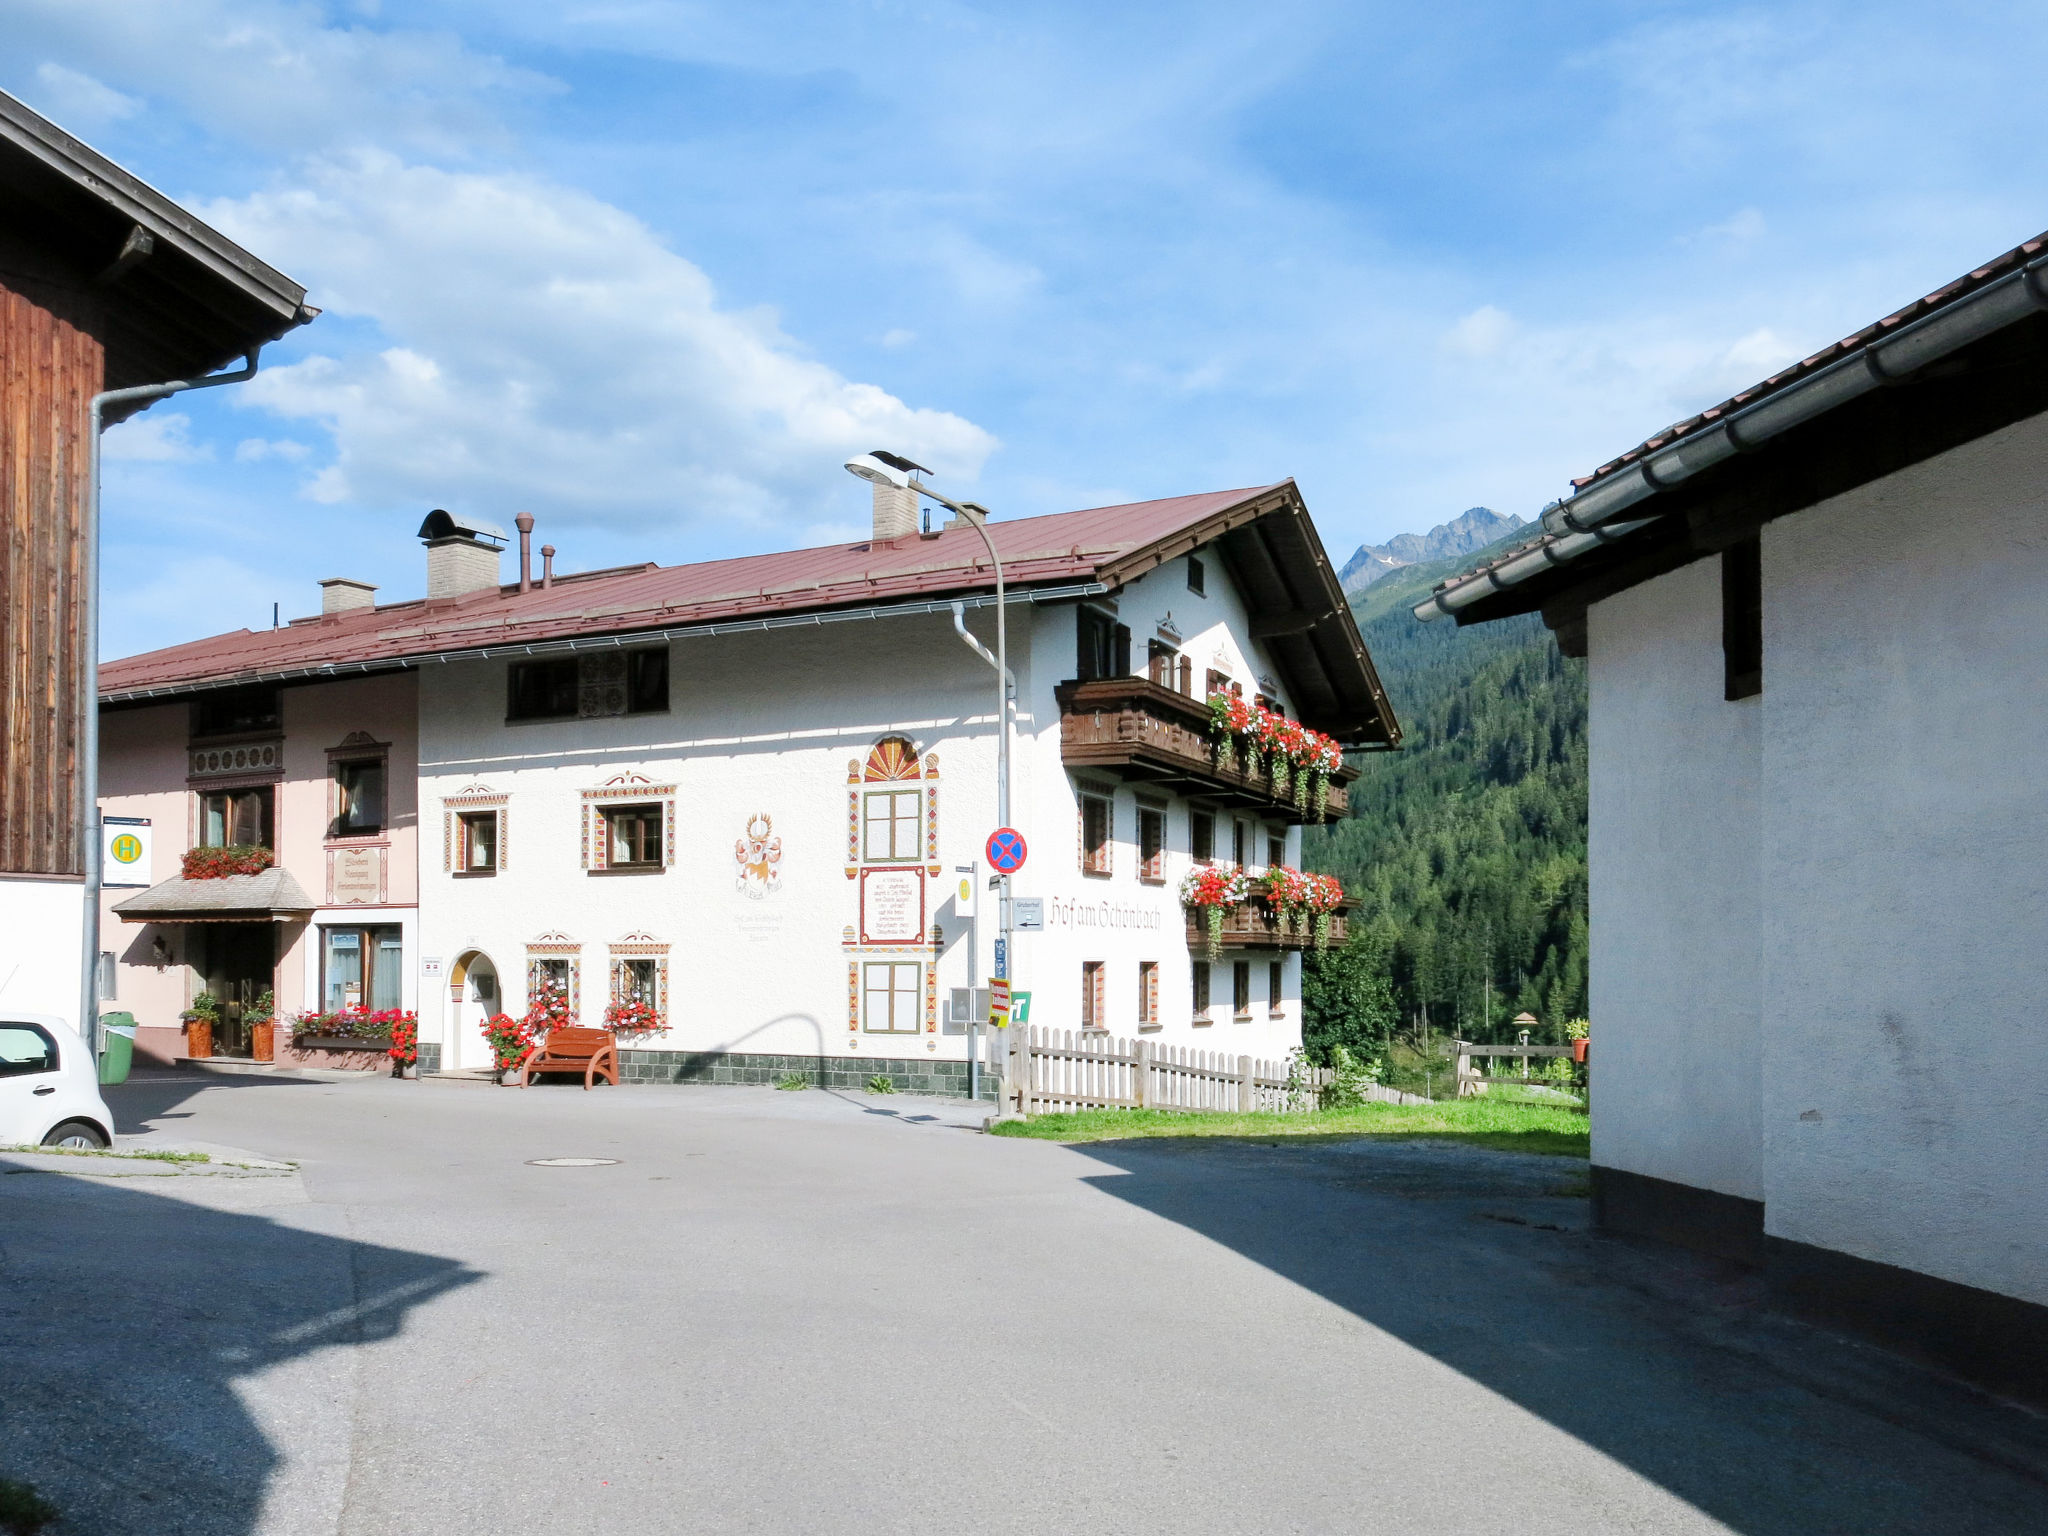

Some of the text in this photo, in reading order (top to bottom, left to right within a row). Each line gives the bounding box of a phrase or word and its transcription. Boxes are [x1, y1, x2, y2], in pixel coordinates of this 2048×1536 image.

[119, 839, 135, 858] H
[1049, 896, 1160, 936] Hof am Schönbach
